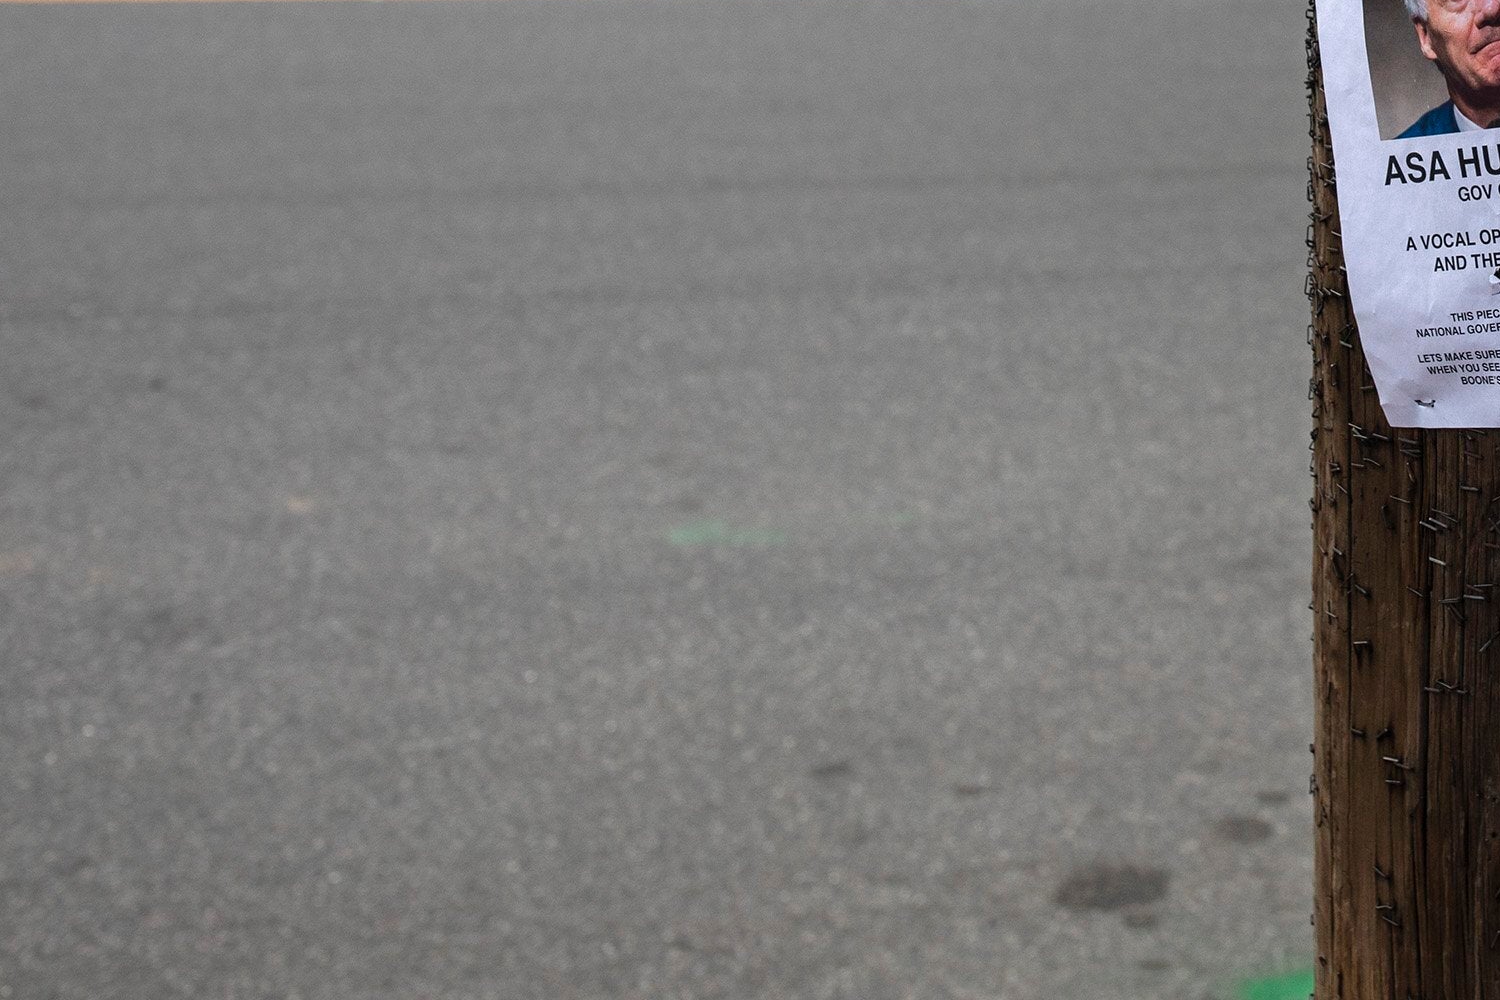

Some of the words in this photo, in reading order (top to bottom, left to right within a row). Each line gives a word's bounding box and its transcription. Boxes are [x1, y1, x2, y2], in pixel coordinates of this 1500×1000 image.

[1384, 150, 1451, 186] ASA
[1458, 184, 1493, 202] GOV
[1406, 236, 1417, 251] A
[1420, 232, 1476, 250] VOCAL
[1434, 255, 1467, 272] AND
[1451, 312, 1474, 323] THIS
[1416, 326, 1465, 338] NATIONAL
[1418, 353, 1443, 364] LETS
[1444, 350, 1473, 362] MAKE
[1475, 349, 1500, 360] SURE
[1427, 364, 1459, 375] WHEN
[1459, 362, 1480, 374] YOU
[1482, 361, 1500, 372] SEE
